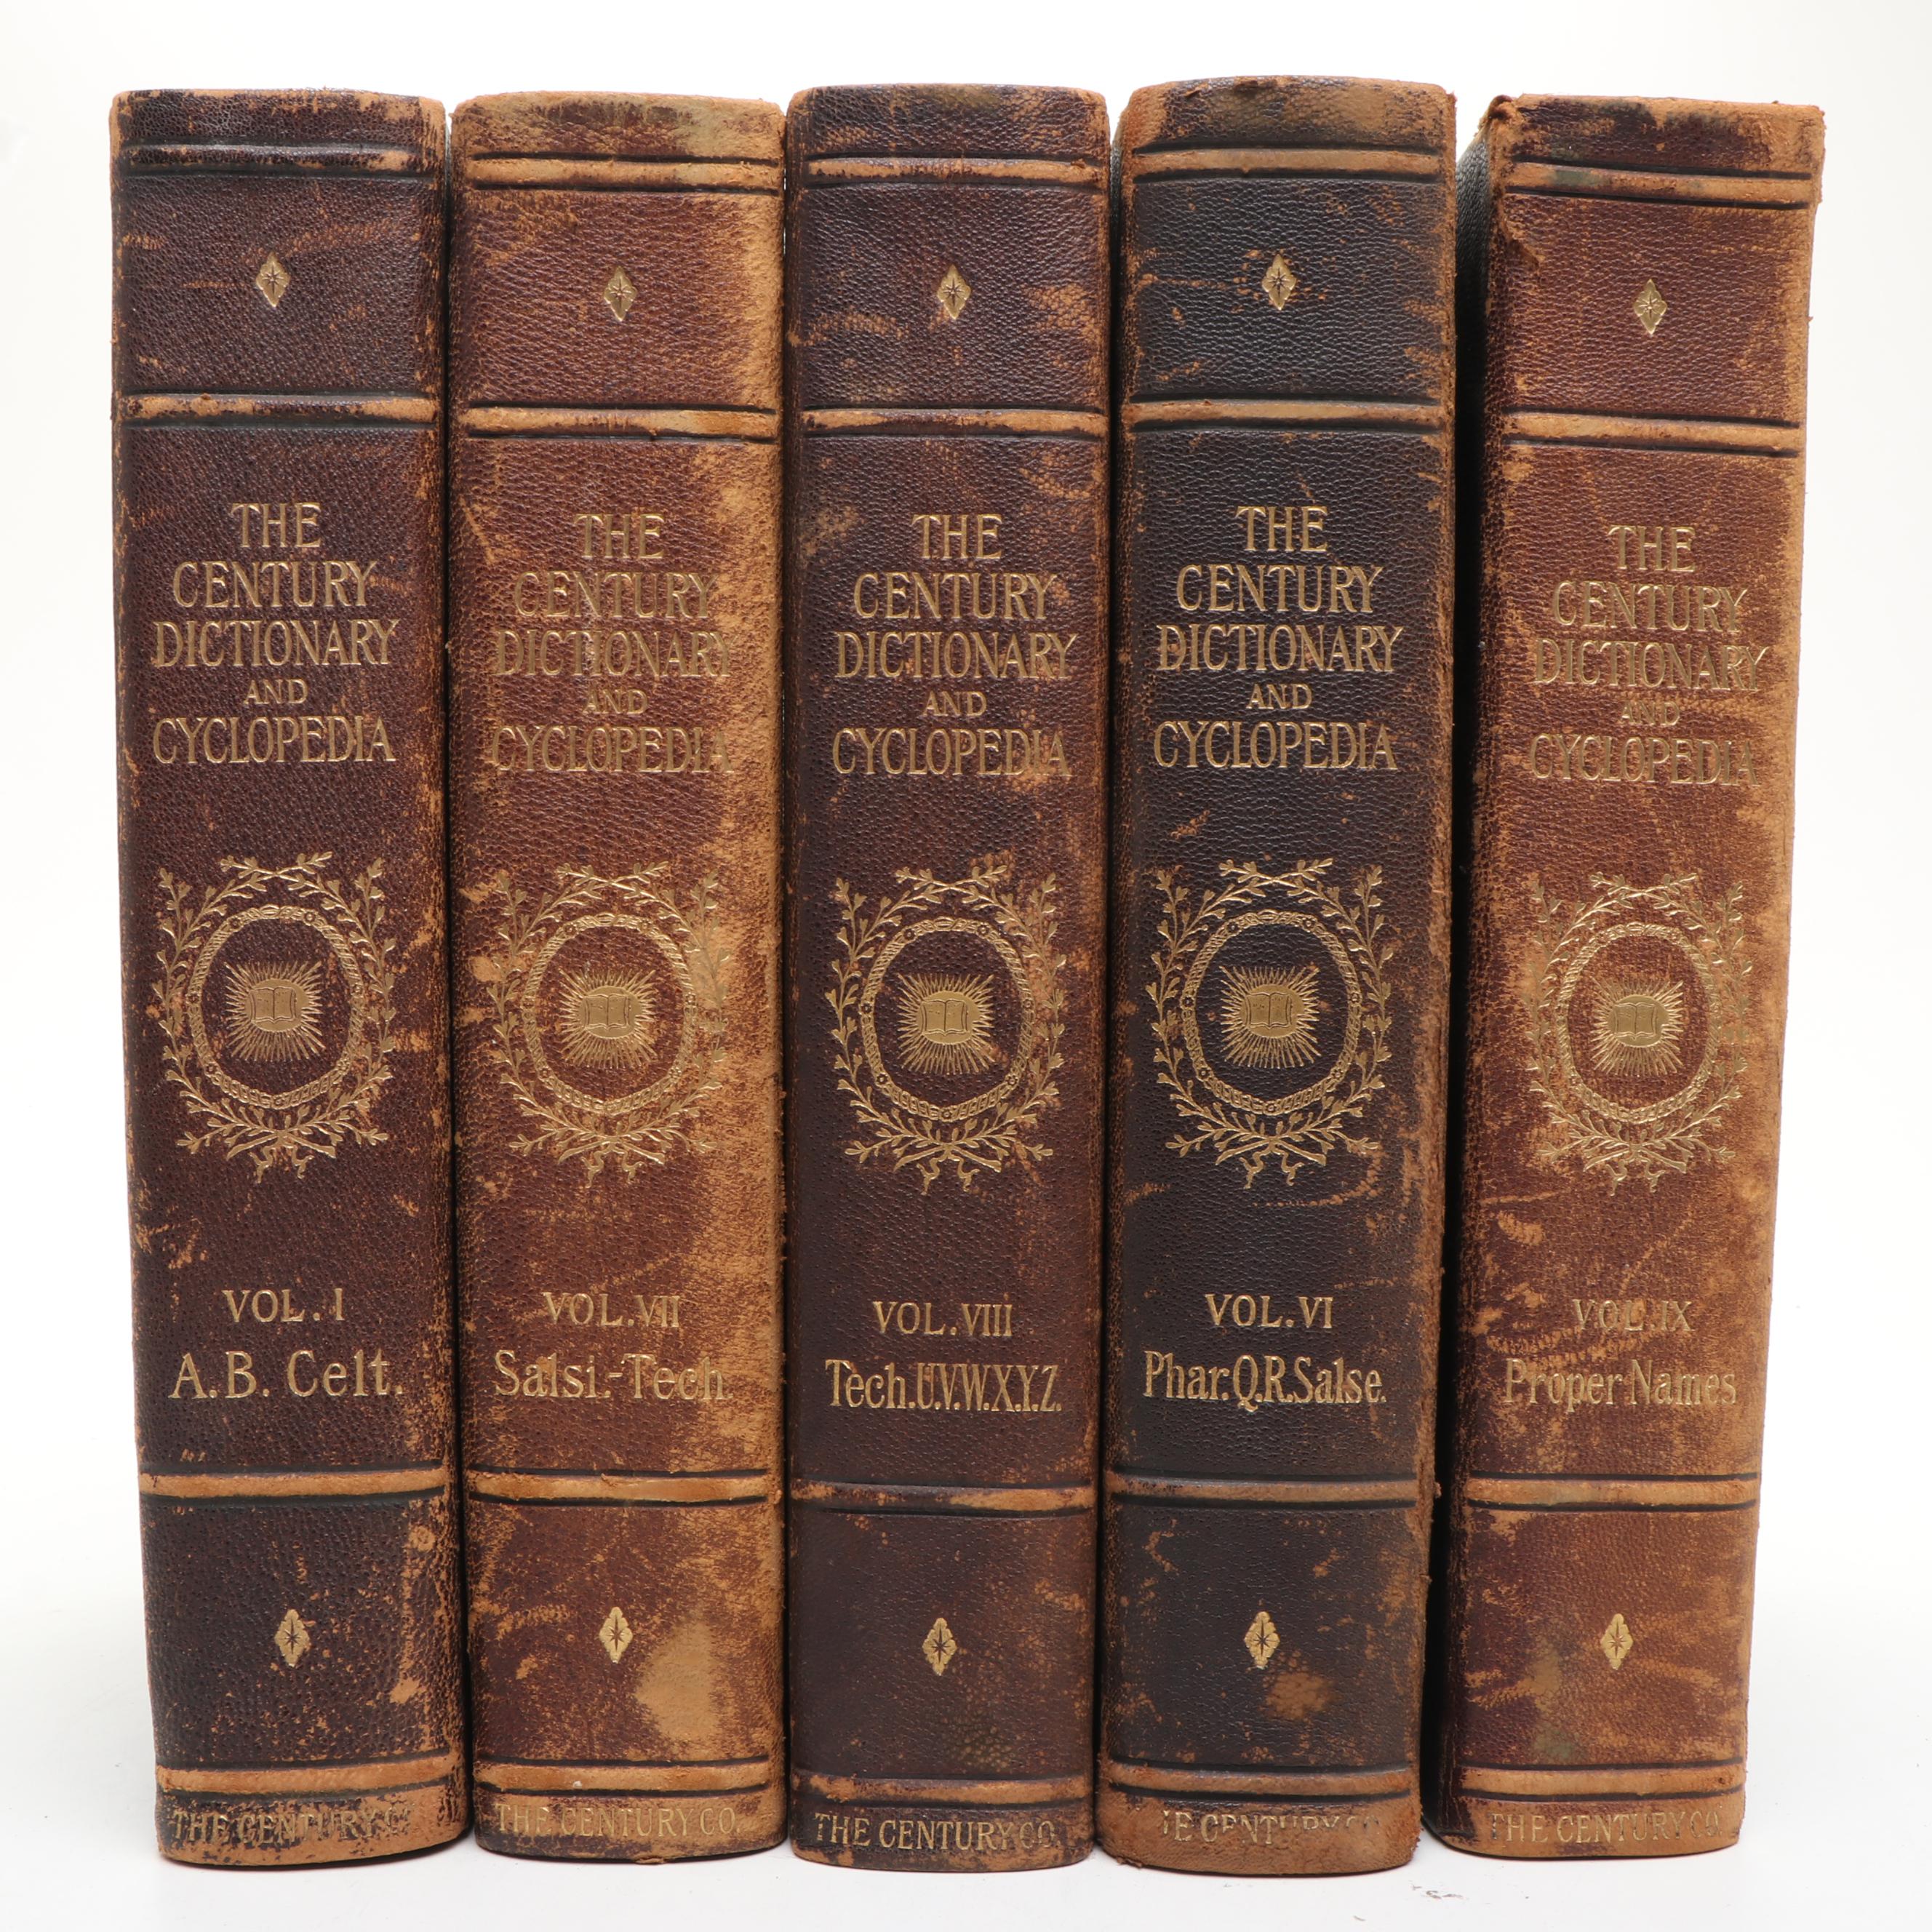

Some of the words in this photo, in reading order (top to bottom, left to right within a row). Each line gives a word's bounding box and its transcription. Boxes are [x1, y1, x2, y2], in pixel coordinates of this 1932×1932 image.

[231, 502, 322, 548] THE
[574, 513, 666, 560] THE
[911, 513, 1003, 560] THE
[1234, 505, 1329, 553] THE
[1608, 524, 1696, 572] THE
[173, 561, 380, 609] CENTURY
[514, 571, 720, 619] CENTURY
[853, 572, 1058, 620] CENTURY
[1175, 564, 1384, 615] CENTURY
[1552, 580, 1748, 634] CENTURY
[153, 618, 400, 668] DICTIONARY
[495, 630, 740, 678] DICTIONARY
[834, 631, 1079, 680] DICTIONARY
[1155, 623, 1405, 675] DICTIONARY
[1533, 637, 1770, 692] DICTIONARY
[242, 679, 309, 706] AND
[583, 689, 648, 716] AND
[923, 691, 988, 718] AND
[1245, 683, 1312, 711] AND
[1621, 701, 1681, 727] AND
[152, 715, 396, 765] CYCLOPEDIA
[491, 726, 735, 774] CYCLOPEDIA
[831, 727, 1073, 778] CYCLOPEDIA
[1153, 721, 1400, 771] CYCLOPEDIA
[1530, 733, 1762, 787] CYCLOPEDIA
[222, 1289, 321, 1322] VOL.
[287, 1349, 404, 1397] Celt.
[1504, 1357, 1624, 1413] Proper
[1629, 1359, 1738, 1406] Names
[173, 1809, 231, 1843] THE
[237, 1808, 380, 1845] CENTURY
[493, 1803, 554, 1837] THE
[559, 1806, 692, 1838] CENTURY
[698, 1806, 741, 1835] CO.
[813, 1812, 871, 1848] THE
[878, 1819, 1016, 1851] CENTURY
[1488, 1812, 1549, 1843] THE
[1555, 1811, 1688, 1845] CENTURY
